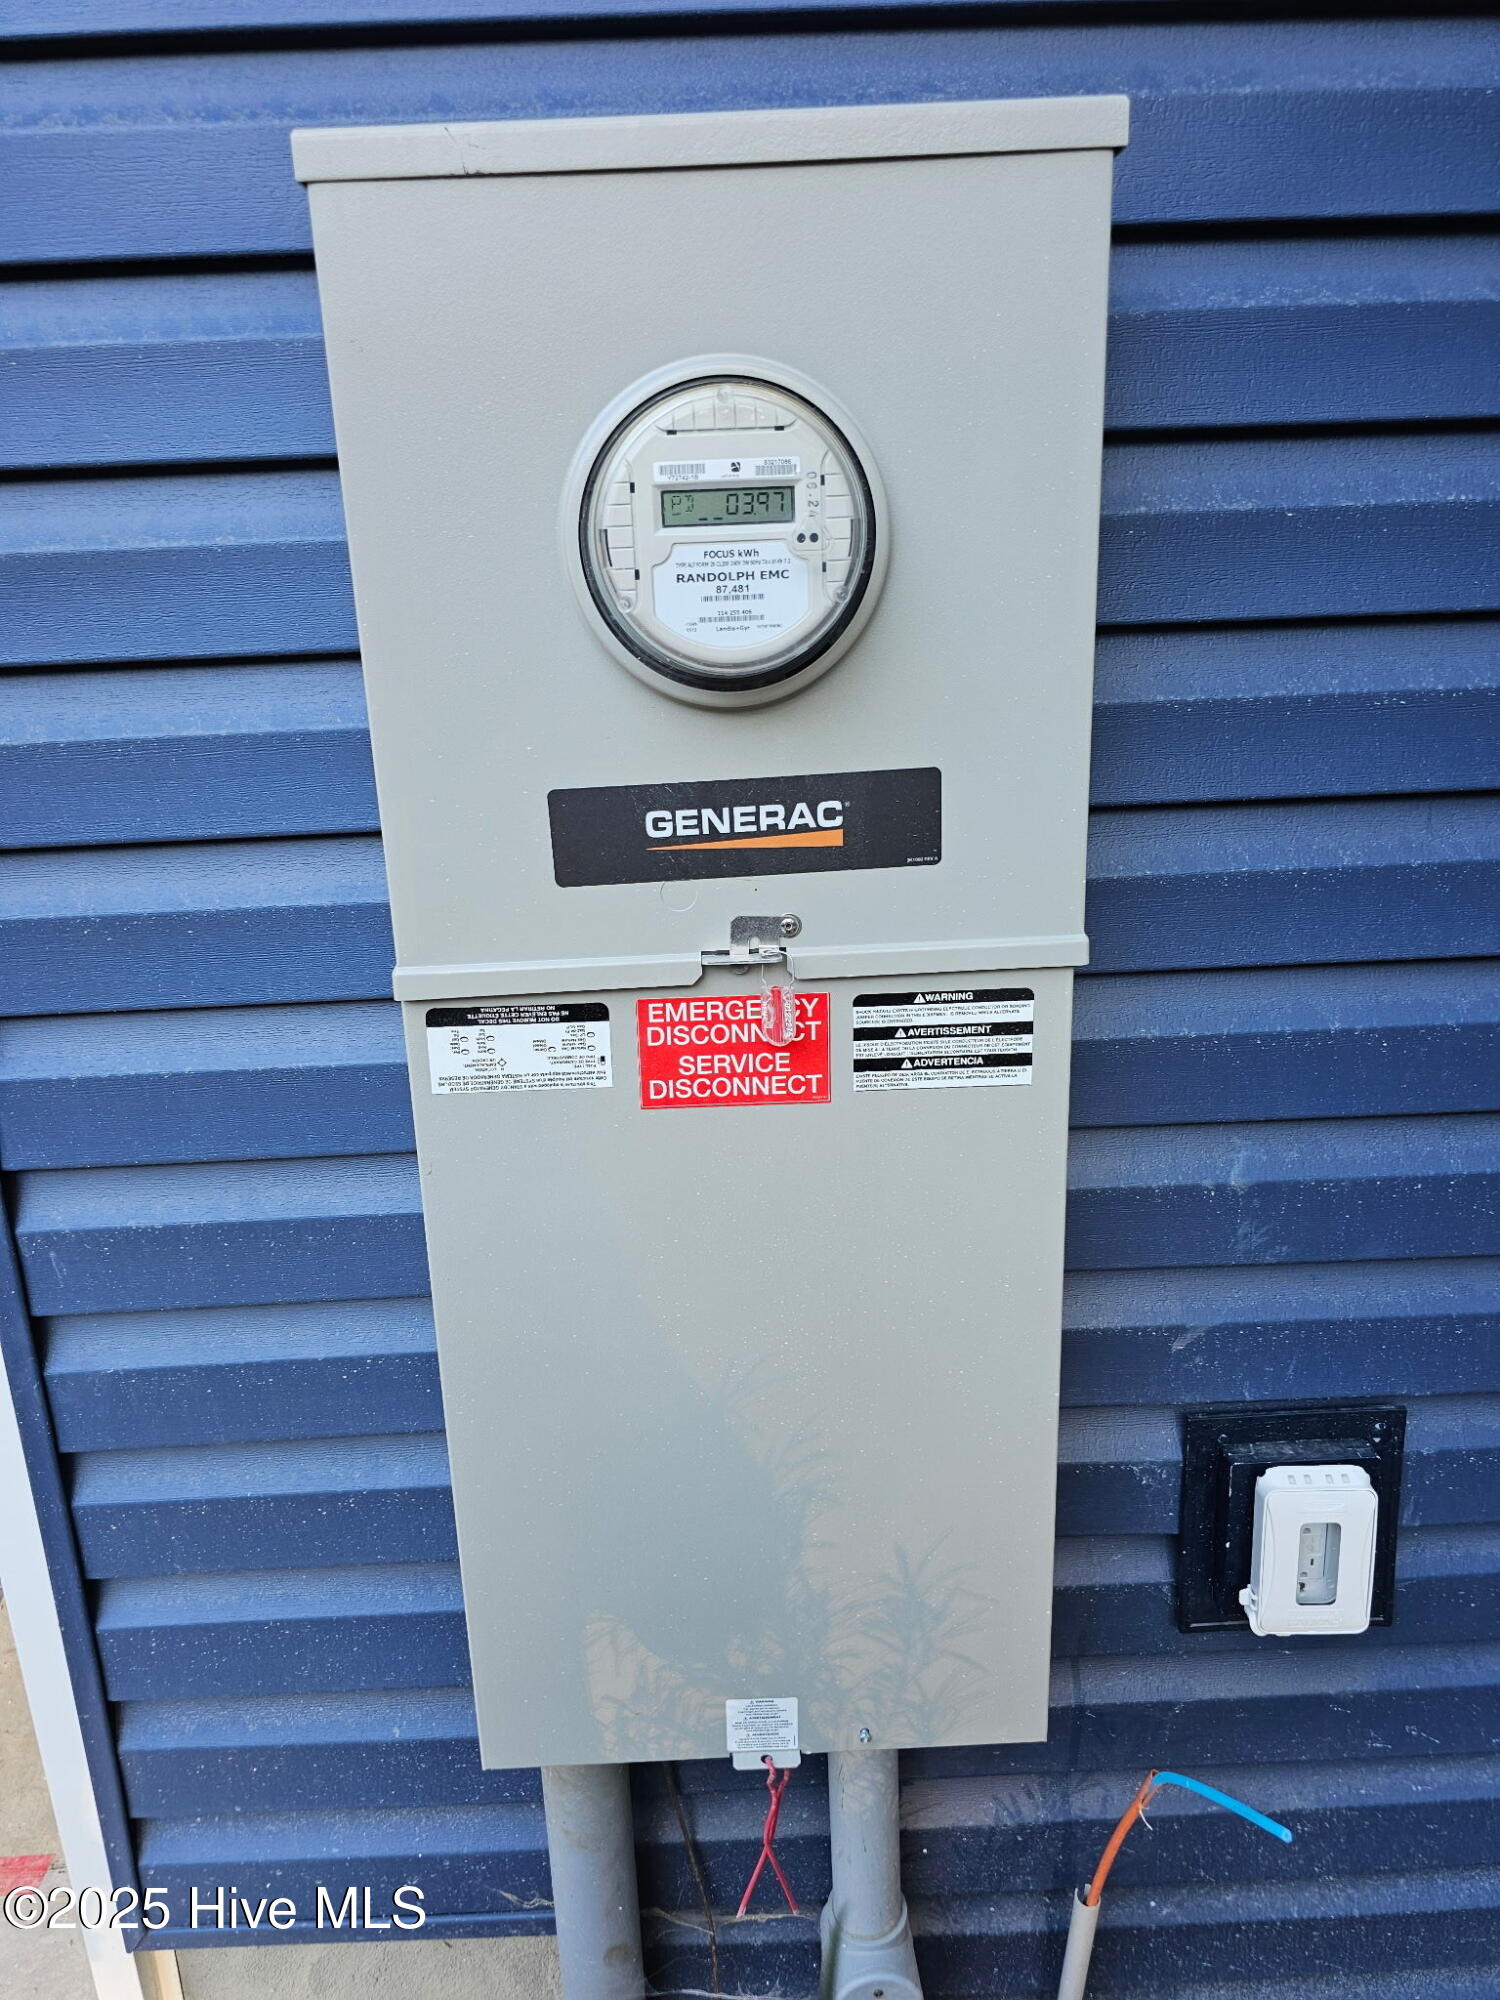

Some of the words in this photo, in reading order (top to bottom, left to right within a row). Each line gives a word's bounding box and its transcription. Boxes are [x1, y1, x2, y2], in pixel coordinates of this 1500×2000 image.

[703, 549, 735, 560] FOCUS
[737, 548, 760, 558] kWh
[675, 570, 755, 584] RANDOLPH
[760, 569, 790, 580] EMC
[645, 800, 844, 839] GENERAC
[925, 992, 974, 1003] WARNING
[646, 1020, 822, 1047] DISCONNCT
[907, 1025, 992, 1037] AVERTISSEMENT
[678, 1052, 791, 1076] SERVICE
[913, 1056, 984, 1067] ADVERTENCIA
[649, 1074, 823, 1100] DISCONNECT
